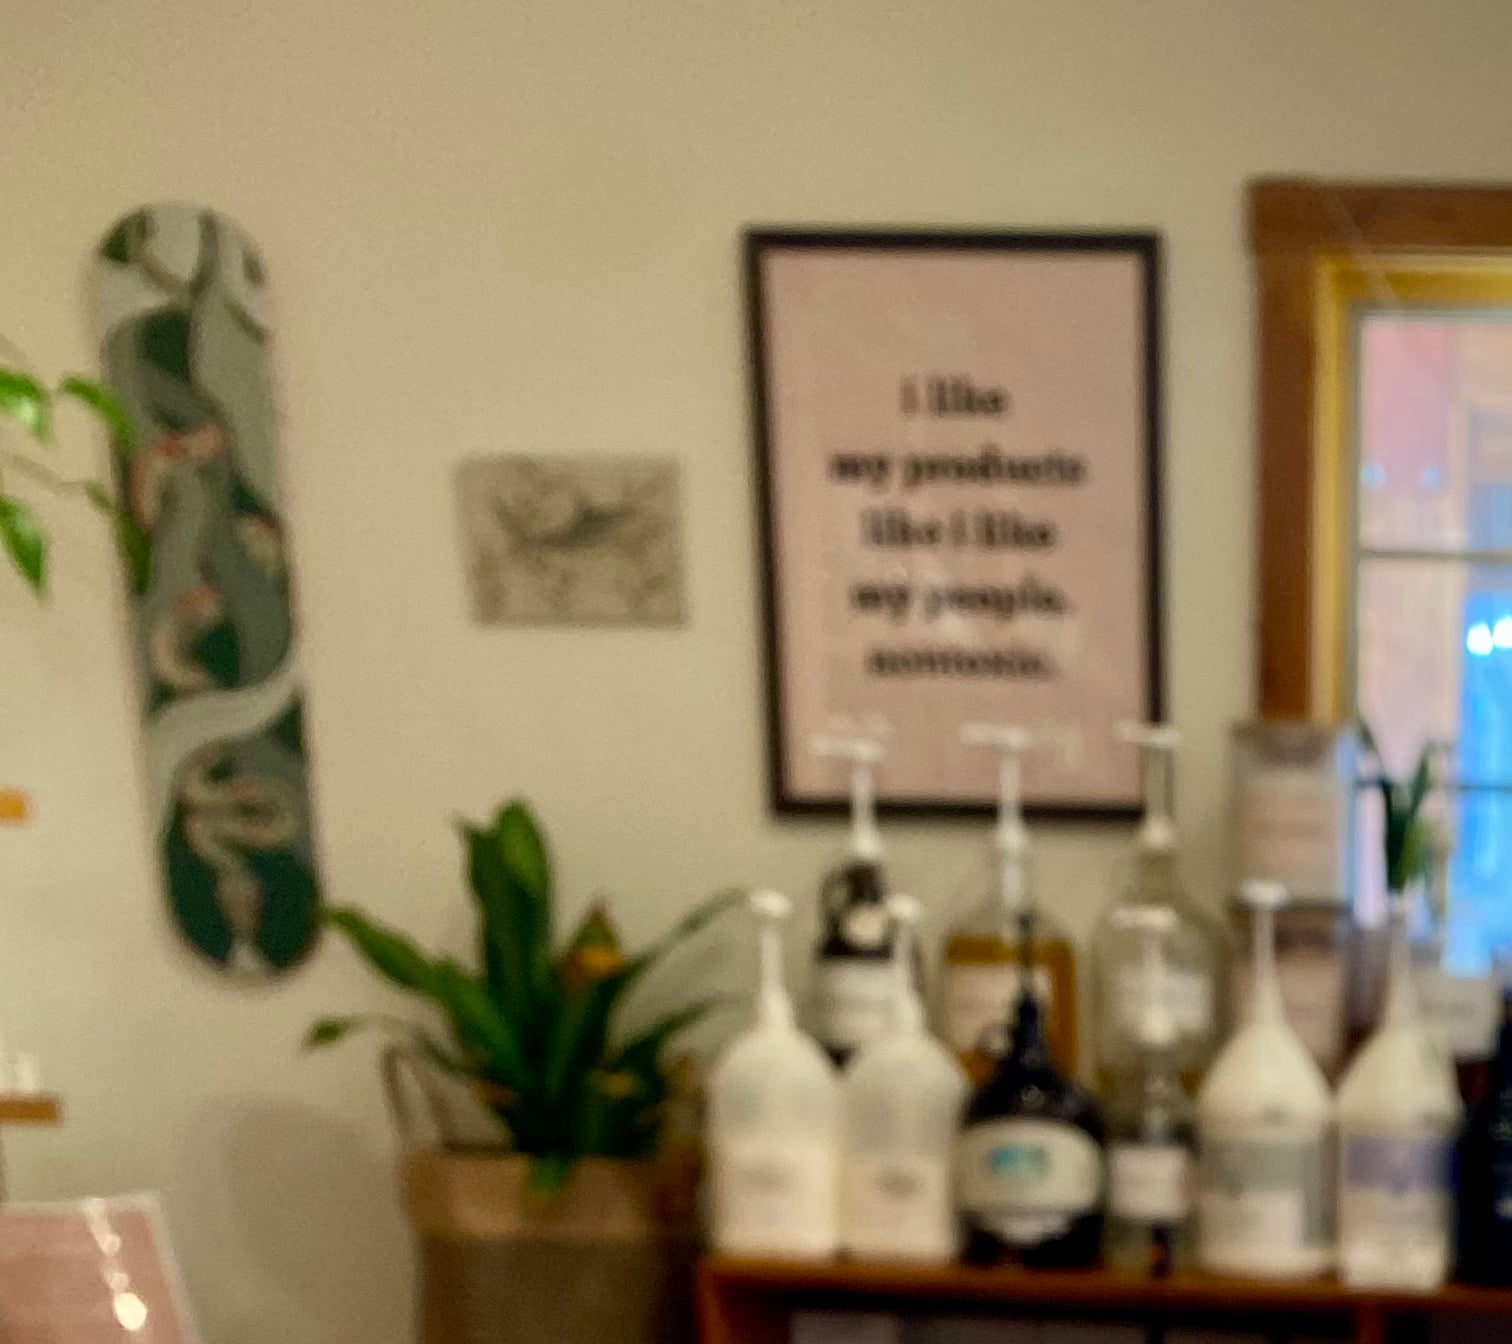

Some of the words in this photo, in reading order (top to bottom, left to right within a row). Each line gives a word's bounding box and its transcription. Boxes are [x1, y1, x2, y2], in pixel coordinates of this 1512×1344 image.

[926, 374, 1008, 417] like
[828, 452, 891, 494] my
[902, 443, 1089, 493] products
[860, 508, 940, 548] like
[974, 508, 1055, 550] like
[850, 582, 909, 624] my
